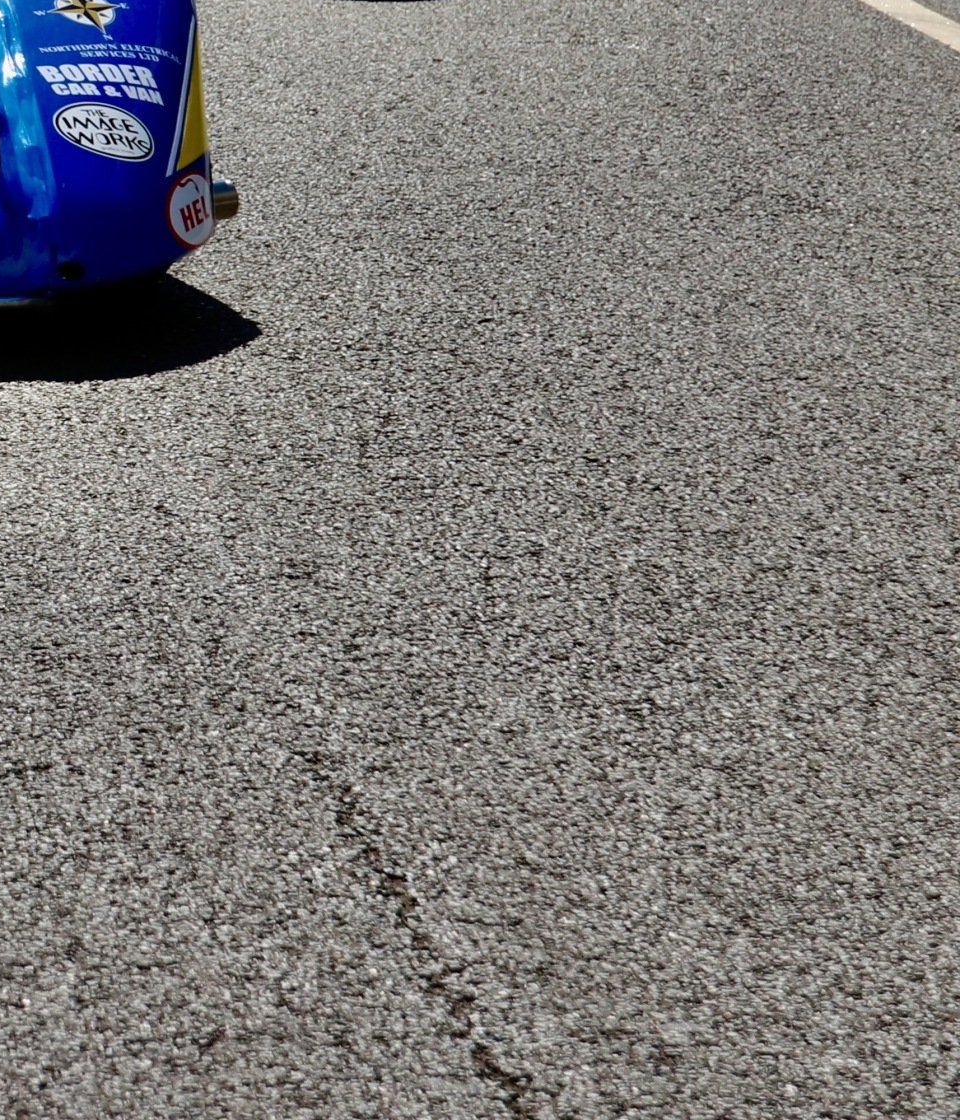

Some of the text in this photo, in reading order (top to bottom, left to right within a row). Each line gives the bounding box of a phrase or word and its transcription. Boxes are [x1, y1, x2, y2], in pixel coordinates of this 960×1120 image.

[39, 43, 182, 65] NORTHDOWN ELECTRICAL
[80, 51, 160, 63] SERVICES LTD
[36, 64, 158, 89] BORDER
[51, 83, 165, 107] CAR & VAN
[62, 115, 135, 134] IMAGE
[83, 109, 109, 118] THE
[67, 132, 152, 156] WORKS
